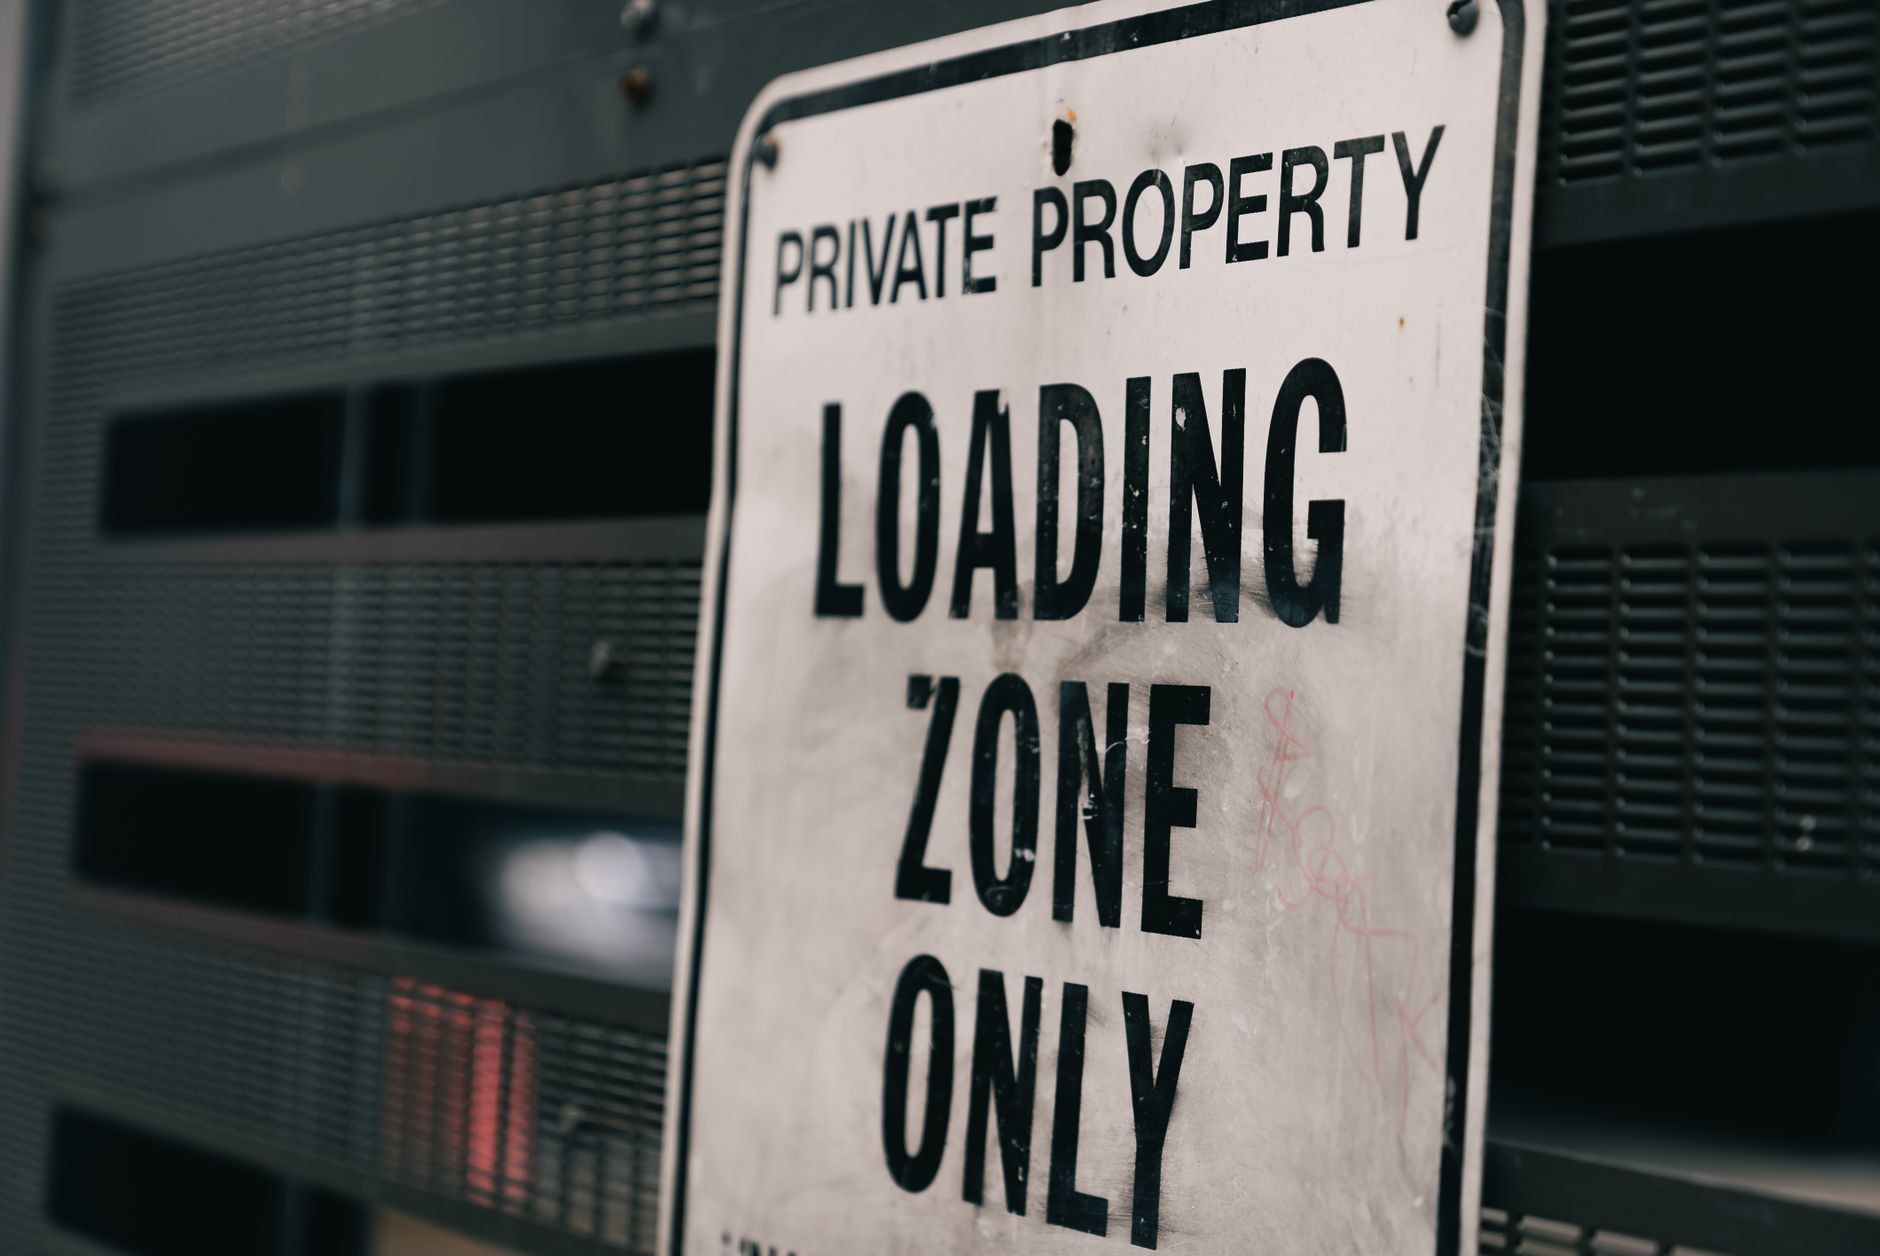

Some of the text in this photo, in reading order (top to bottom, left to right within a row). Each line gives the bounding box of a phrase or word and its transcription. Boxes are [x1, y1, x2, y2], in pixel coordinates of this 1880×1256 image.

[772, 125, 1446, 316] PRIVATE PROPERTY
[813, 357, 1348, 628] LOADING
[893, 672, 1212, 940] ZONE
[881, 953, 1195, 1251] ONLY
